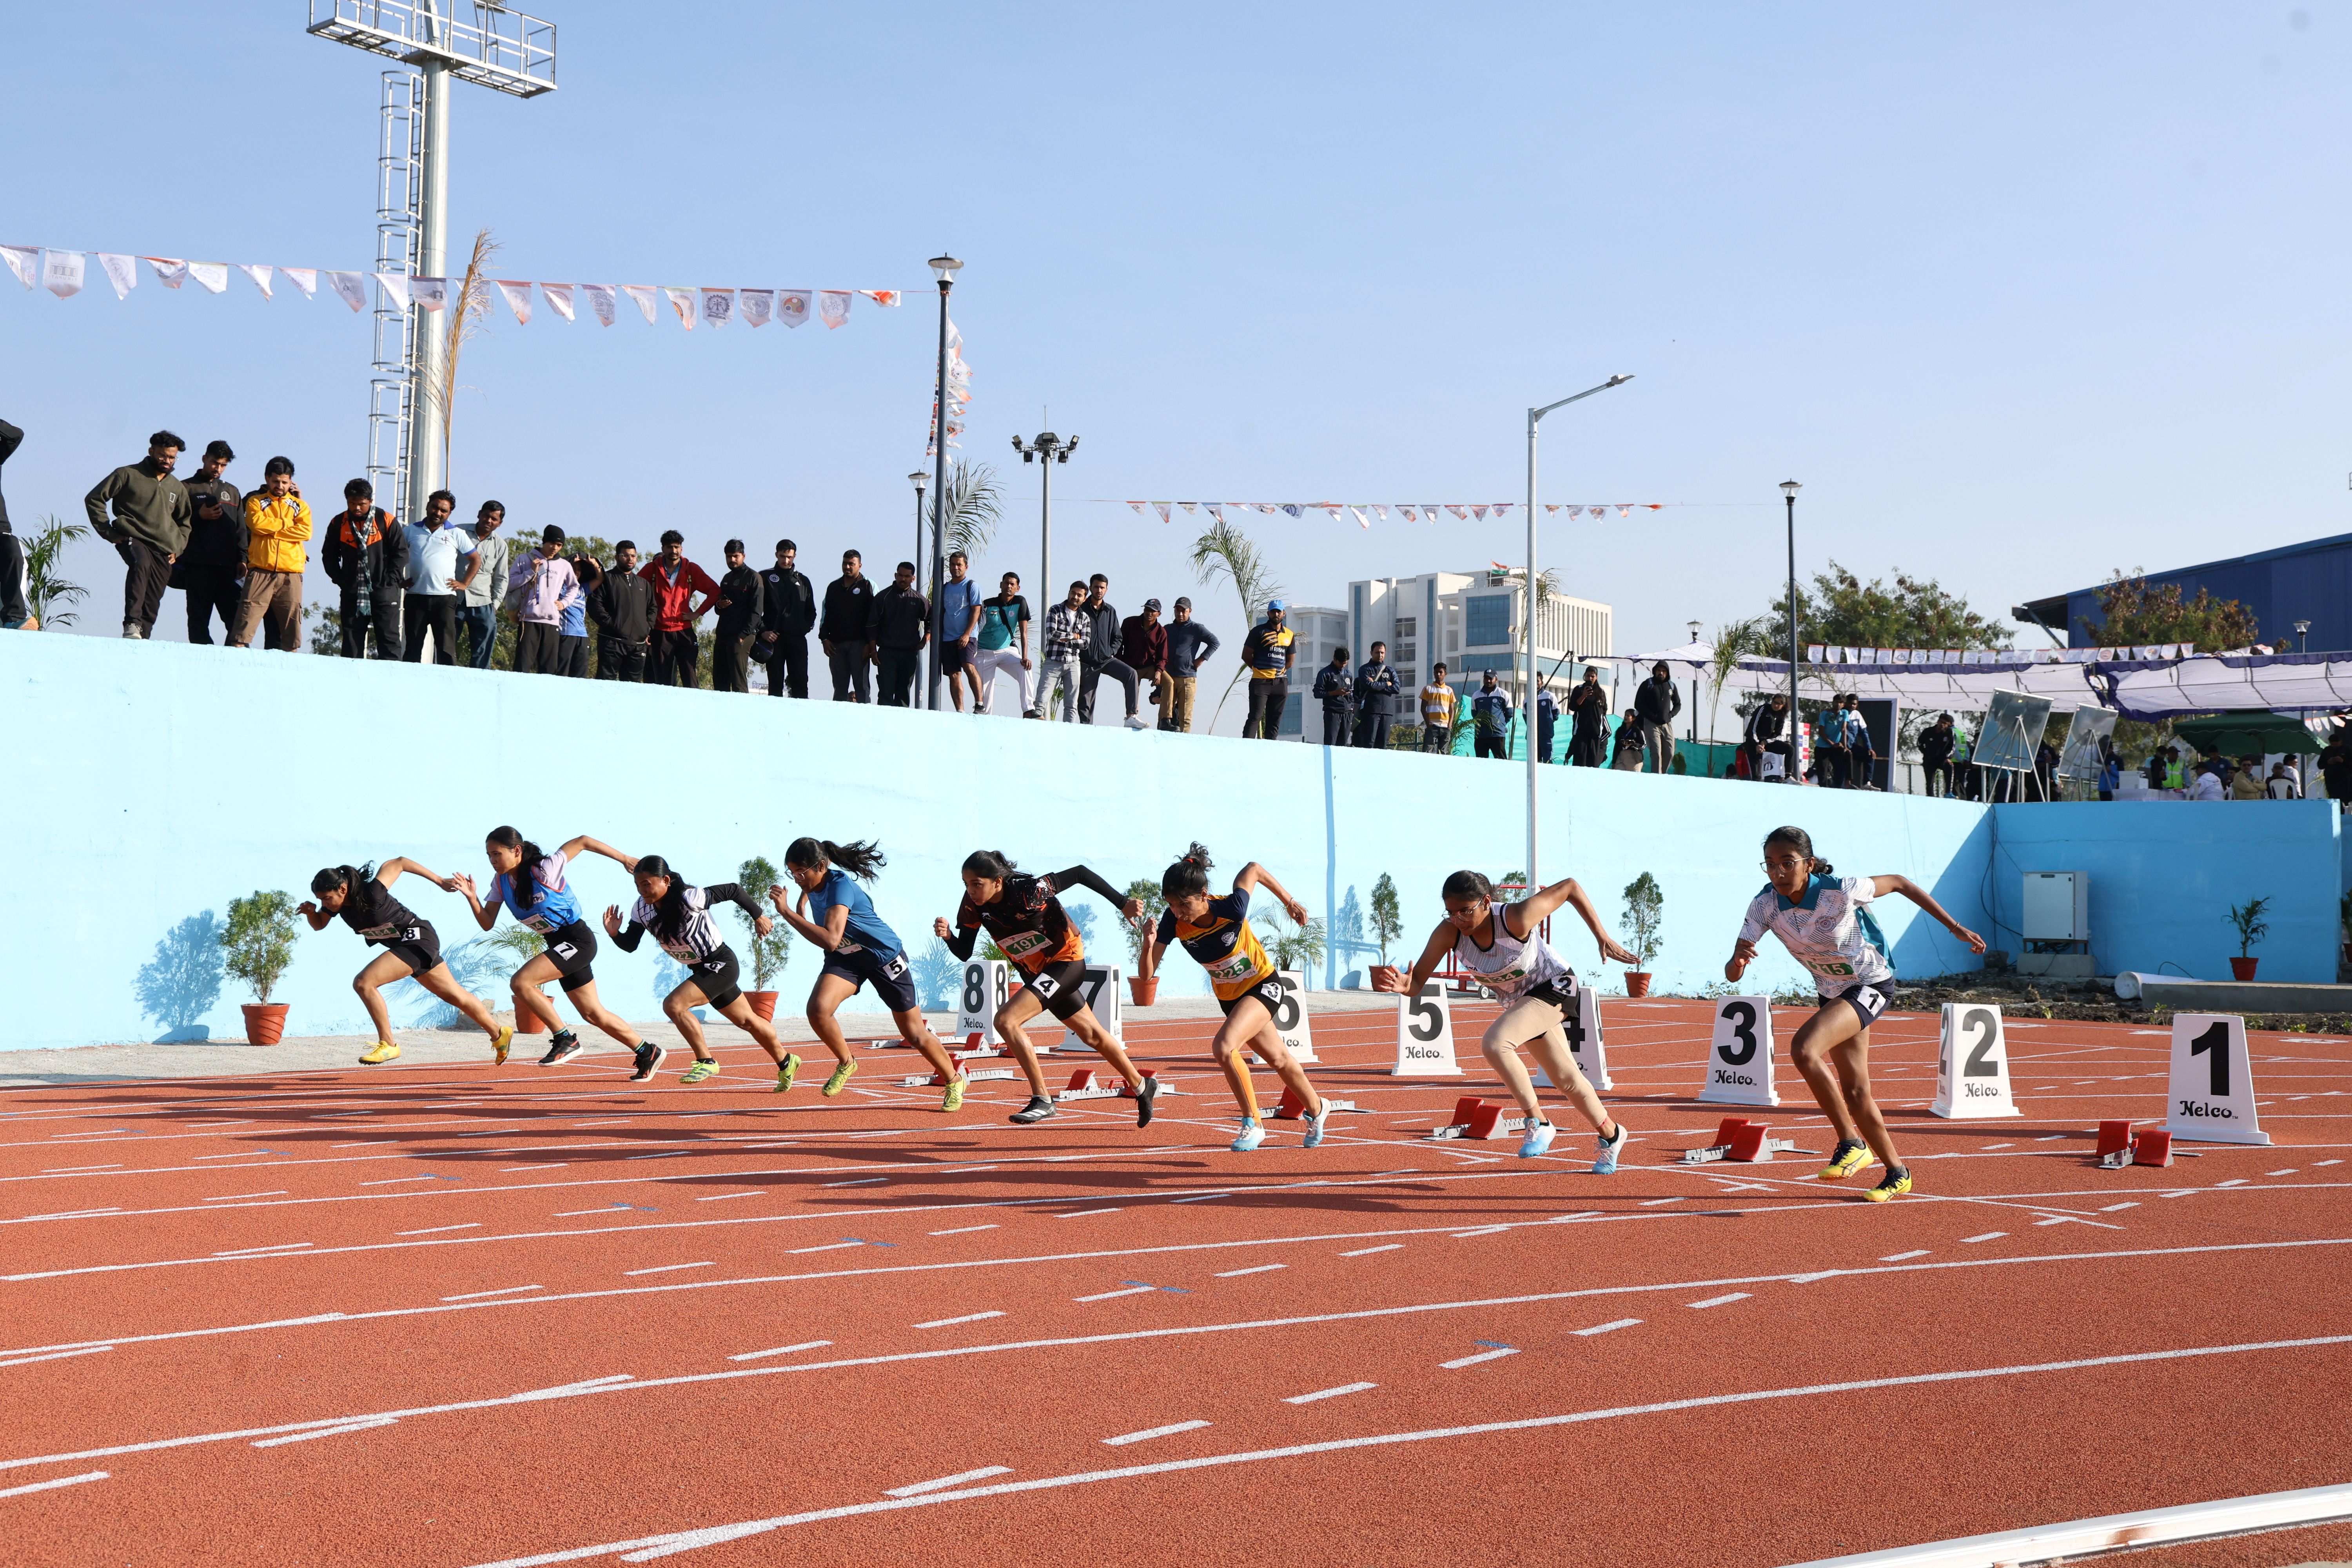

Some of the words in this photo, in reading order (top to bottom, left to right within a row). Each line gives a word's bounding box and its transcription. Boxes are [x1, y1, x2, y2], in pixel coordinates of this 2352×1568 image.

[405, 929, 415, 939] 8
[560, 944, 574, 954] 7
[1013, 936, 1038, 952] 197
[670, 951, 691, 960] 122
[889, 960, 903, 975] 5
[1216, 961, 1245, 979] 225
[1039, 979, 1054, 993] 4
[1483, 973, 1516, 983] 134
[1558, 976, 1572, 995] 2
[964, 964, 984, 1014] 8
[996, 964, 1006, 1011] 8
[1083, 969, 1107, 1012] 7
[1272, 977, 1300, 1031] 6
[1868, 993, 1880, 1010] 1
[1408, 984, 1443, 1042] 5
[964, 1017, 983, 1029] Nelco
[1282, 1036, 1299, 1047] lco
[1717, 1001, 1757, 1066] 3
[1939, 1007, 1949, 1076] 2
[1962, 1009, 1998, 1077] 2
[1405, 1046, 1440, 1059] Nelco
[2191, 1022, 2230, 1096] 1
[1715, 1070, 1753, 1085] Nelco
[1965, 1083, 1998, 1097] Nelco
[2180, 1100, 2232, 1118] Nelco
